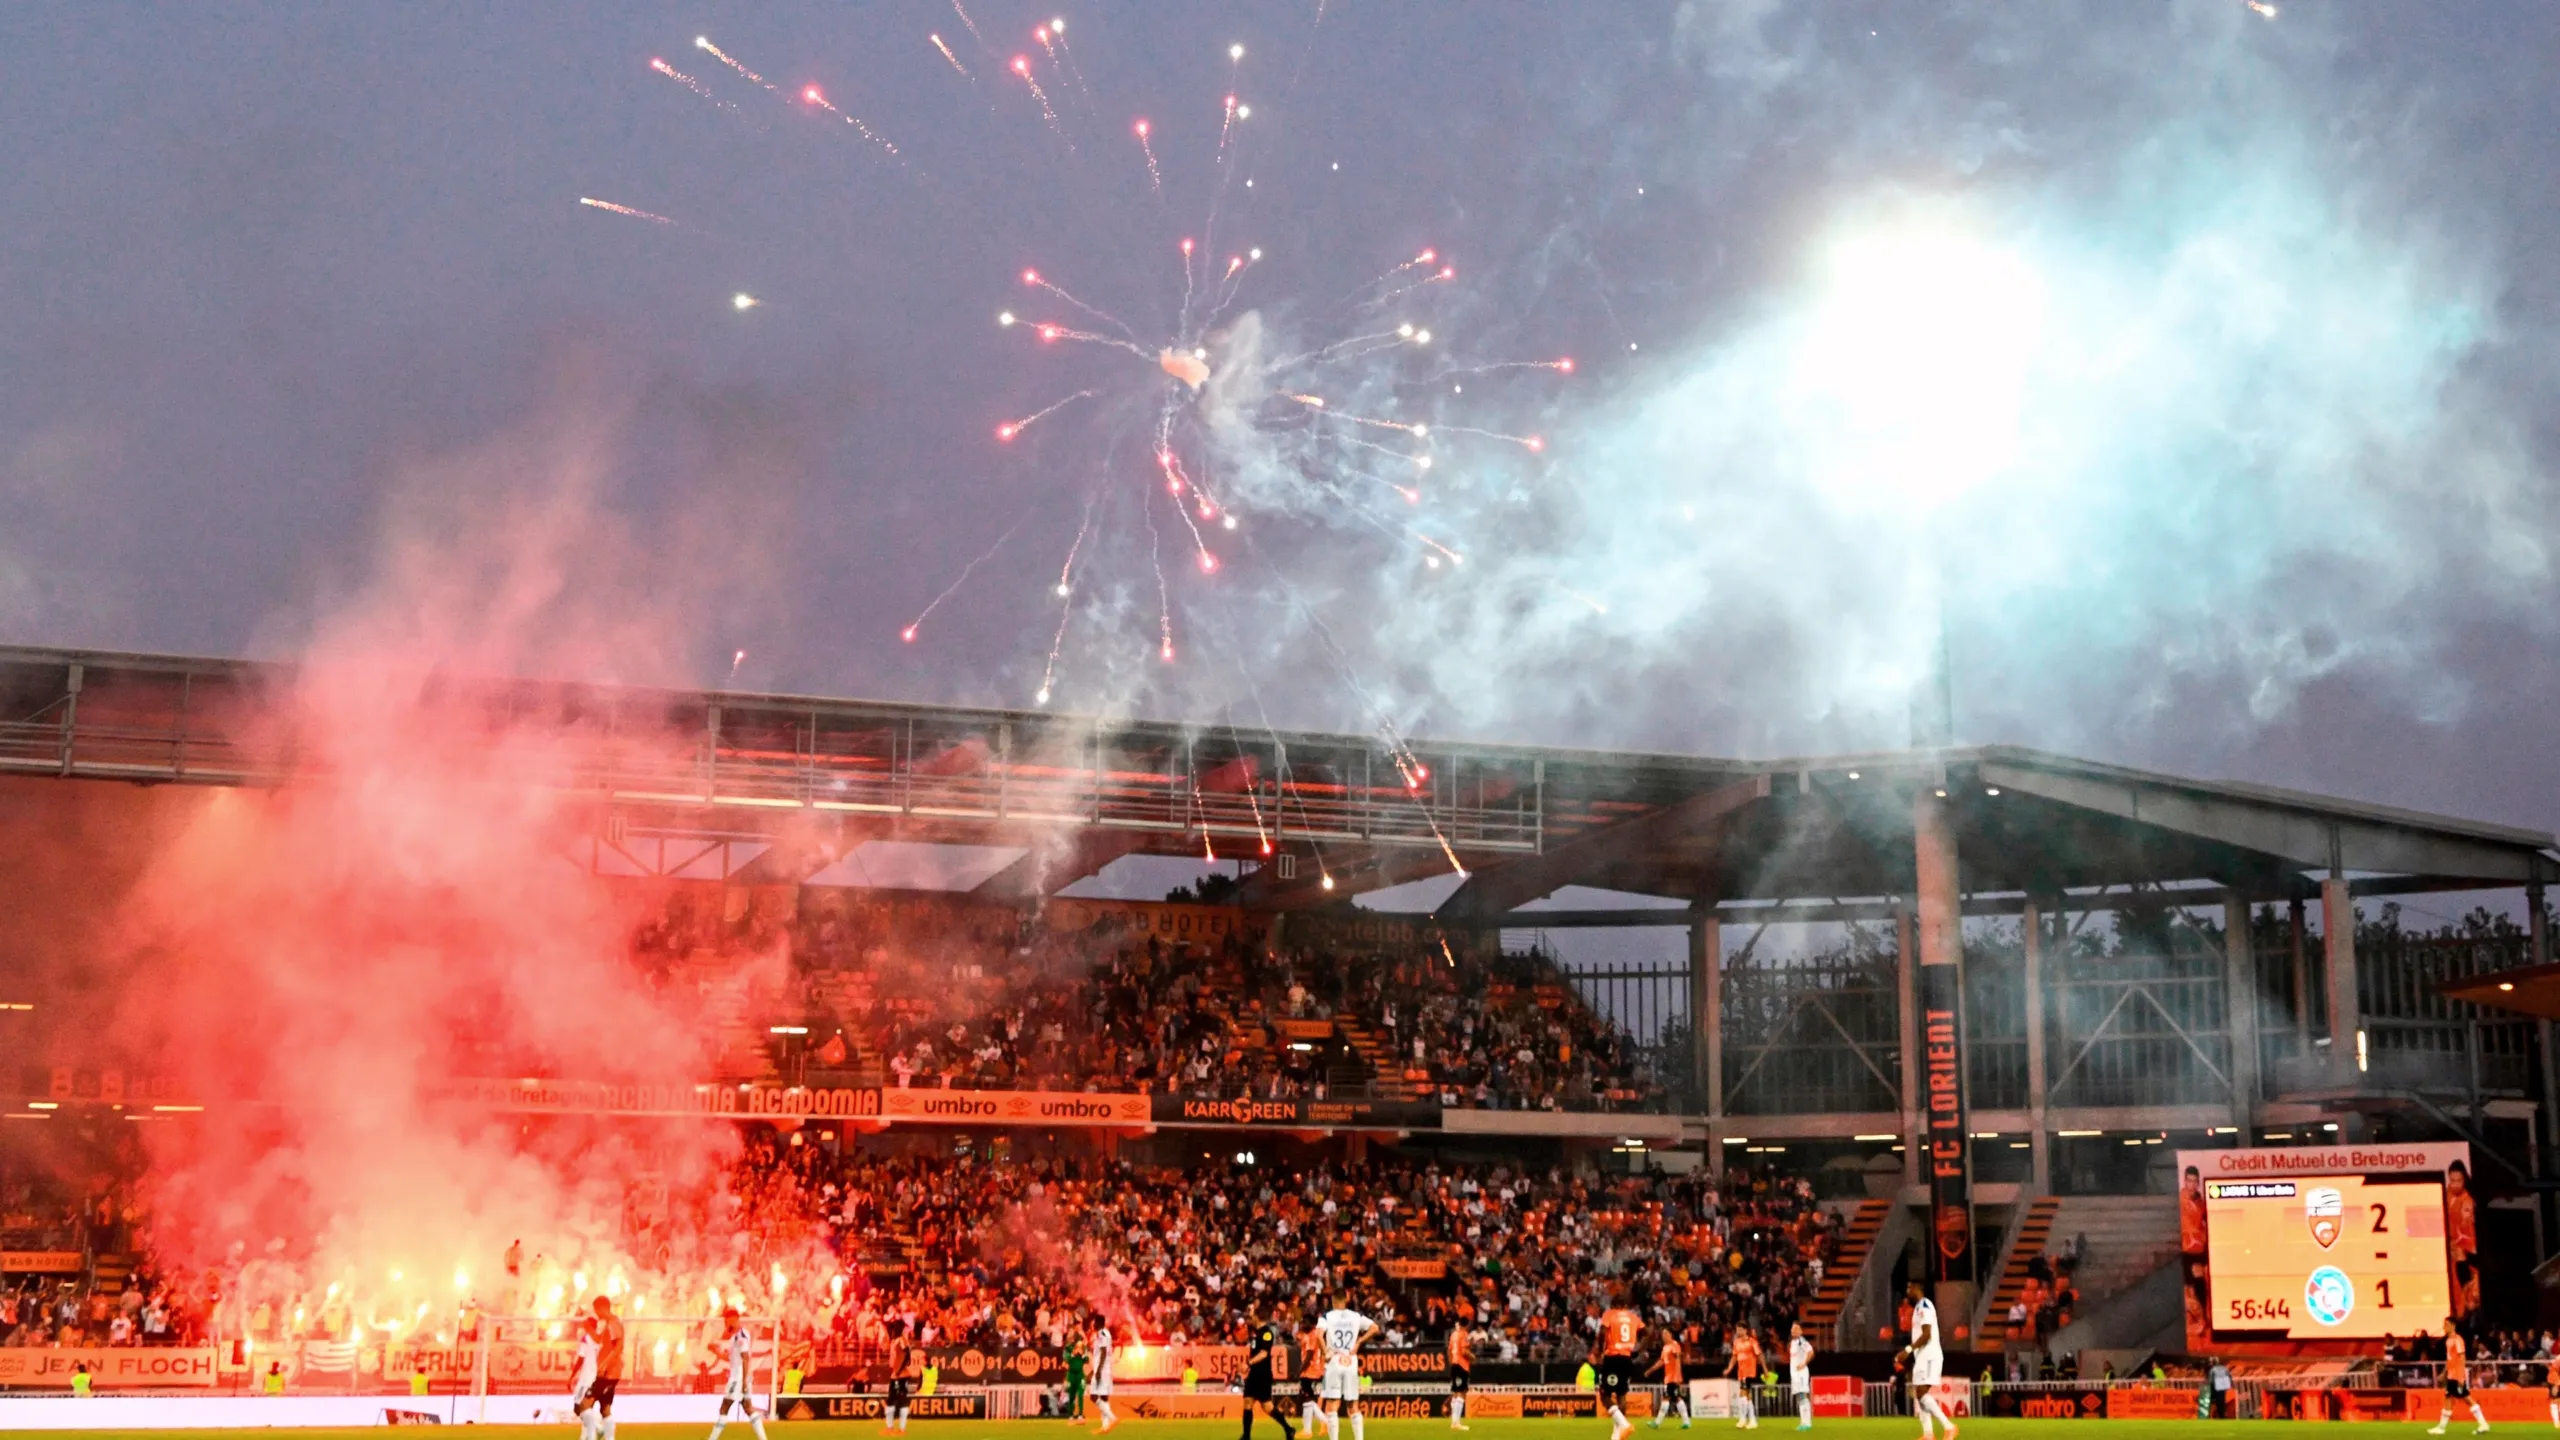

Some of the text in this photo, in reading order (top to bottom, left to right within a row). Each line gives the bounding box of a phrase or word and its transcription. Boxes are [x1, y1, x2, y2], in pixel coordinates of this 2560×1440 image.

[749, 1087, 879, 1115] ACADOMIA
[1926, 1008, 1963, 1177] FC LORIENT
[924, 1097, 1111, 1118] umbro umbro
[2219, 1151, 2426, 1171] Crédit Mutuel de Bretagne
[2370, 1203, 2388, 1233] 2
[2375, 1279, 2394, 1309] 1
[2230, 1298, 2290, 1320] 56:44
[1333, 1329, 1354, 1350] 32
[1620, 1323, 1631, 1342] 9
[34, 1356, 104, 1375] JEAN
[118, 1356, 211, 1375] FLOCH
[930, 1356, 960, 1370] 91.4
[964, 1355, 981, 1366] hit
[986, 1356, 1015, 1370] 91.4
[1019, 1355, 1037, 1366] hit
[1357, 1352, 1446, 1373] ORTINGSOLS
[907, 1398, 975, 1415] MERLIN
[1524, 1397, 1595, 1413] Aménageur
[1813, 1392, 1849, 1405] actual
[2020, 1393, 2076, 1417] umbro
